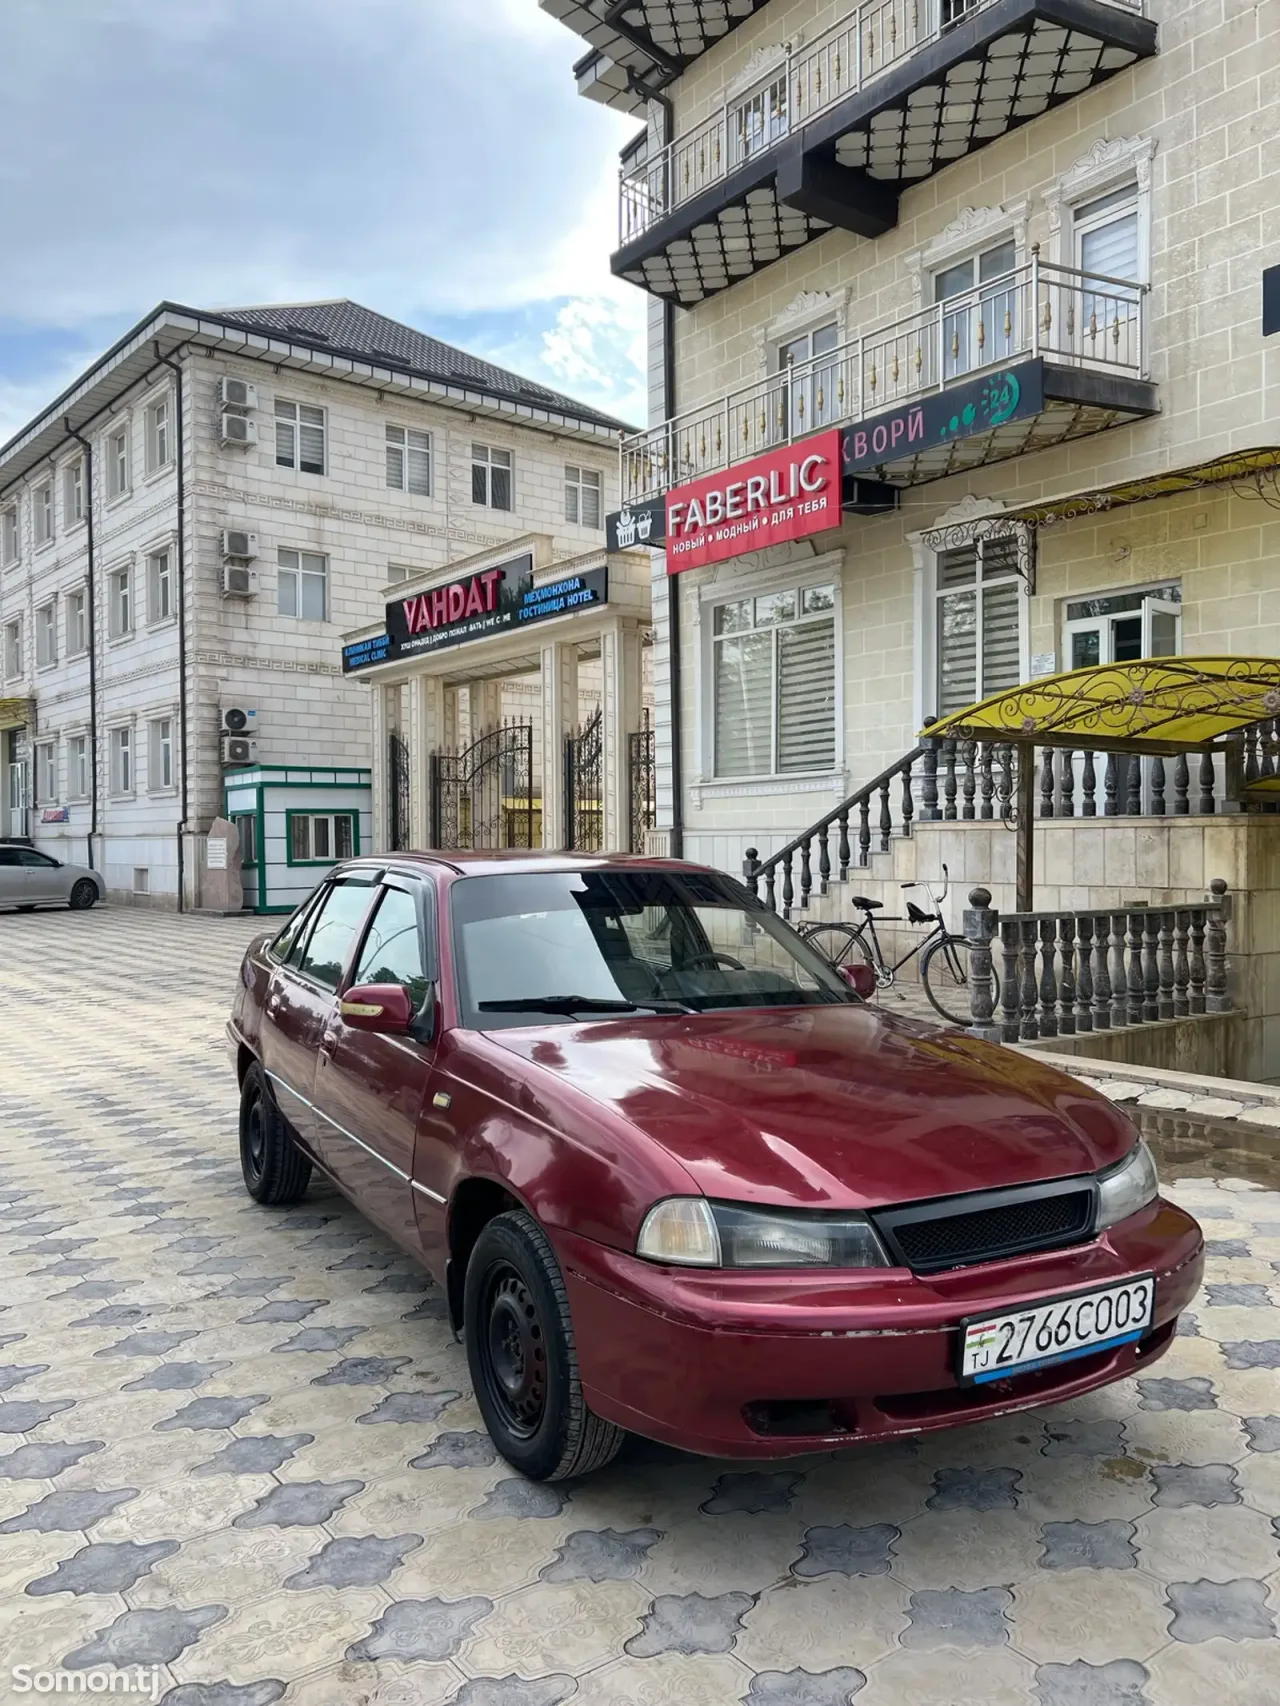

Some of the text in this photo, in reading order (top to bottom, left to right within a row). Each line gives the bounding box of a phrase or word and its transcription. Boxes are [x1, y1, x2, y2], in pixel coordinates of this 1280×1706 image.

[990, 385, 1010, 407] 24
[668, 454, 829, 537] FABERLIC
[672, 496, 828, 555] НОВЫЙ МОДНЫЙ ДЛЯ ТЕБЯ
[403, 570, 502, 635] VAHDAT
[518, 589, 593, 620] ГОСТИНИЦА HOTEL
[972, 1350, 989, 1369] TJ
